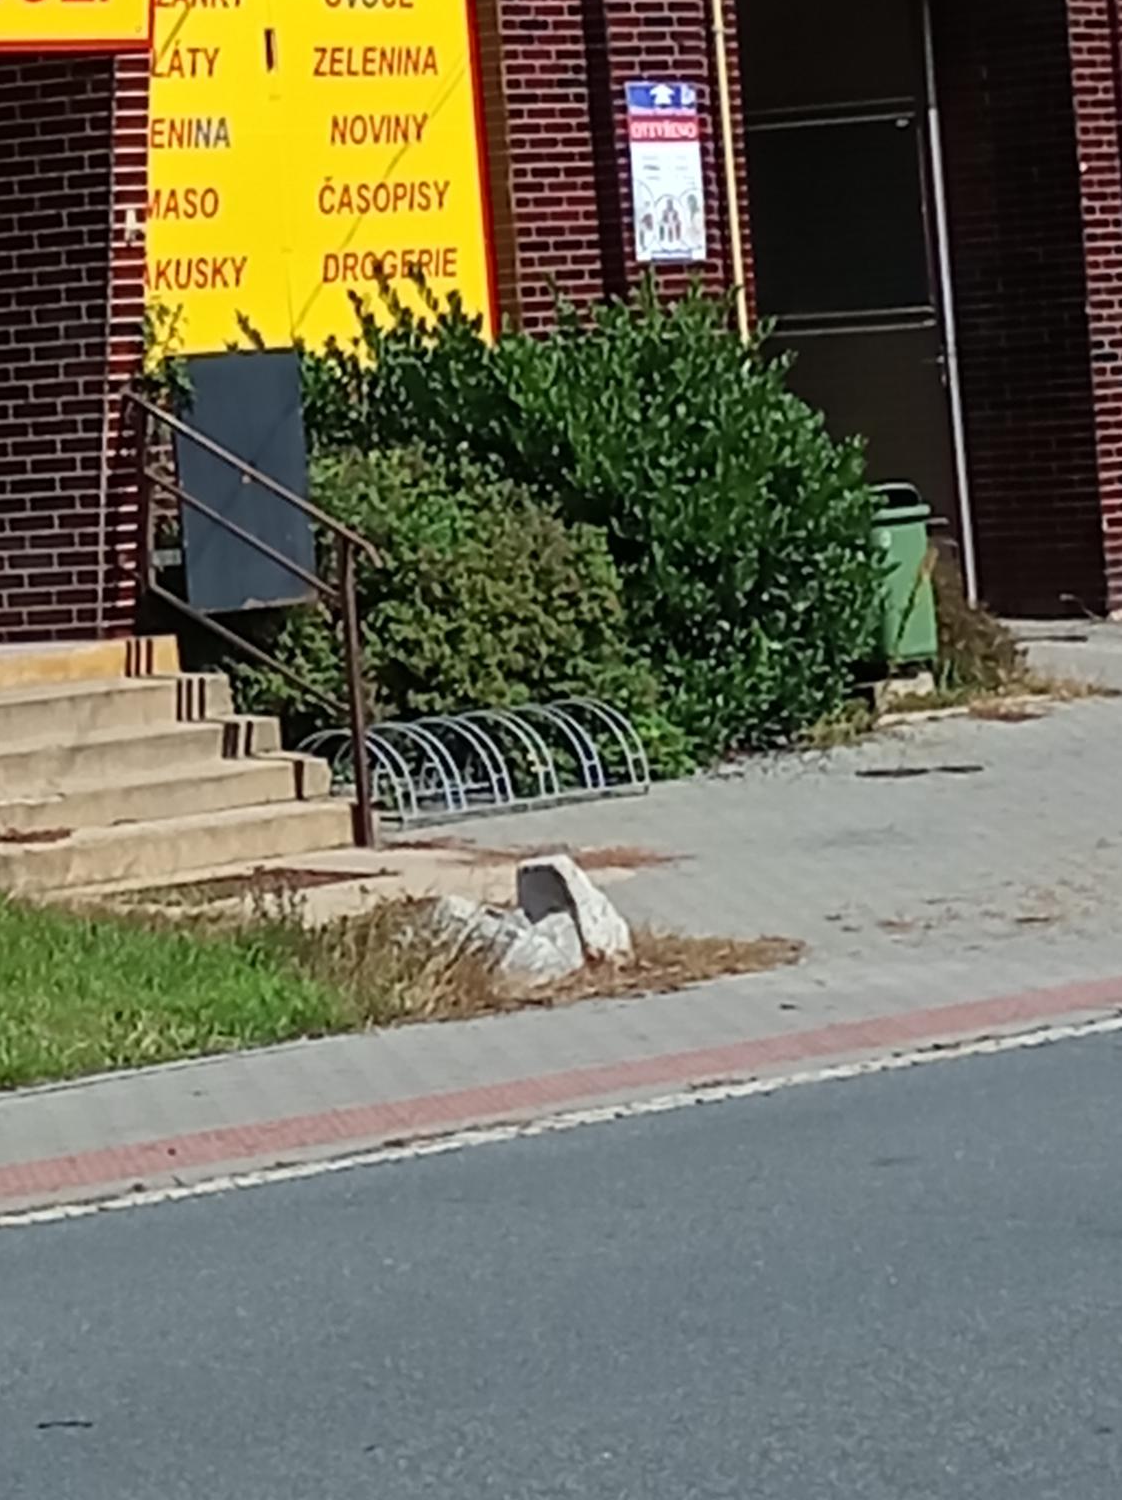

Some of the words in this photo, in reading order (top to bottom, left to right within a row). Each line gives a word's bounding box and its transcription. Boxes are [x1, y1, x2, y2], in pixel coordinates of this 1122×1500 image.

[313, 46, 438, 77] ZELENINA
[150, 117, 230, 149] ENINA
[330, 113, 428, 145] NOVINY
[318, 177, 450, 214] ČASOPISY
[322, 247, 458, 283] DROGERIE
